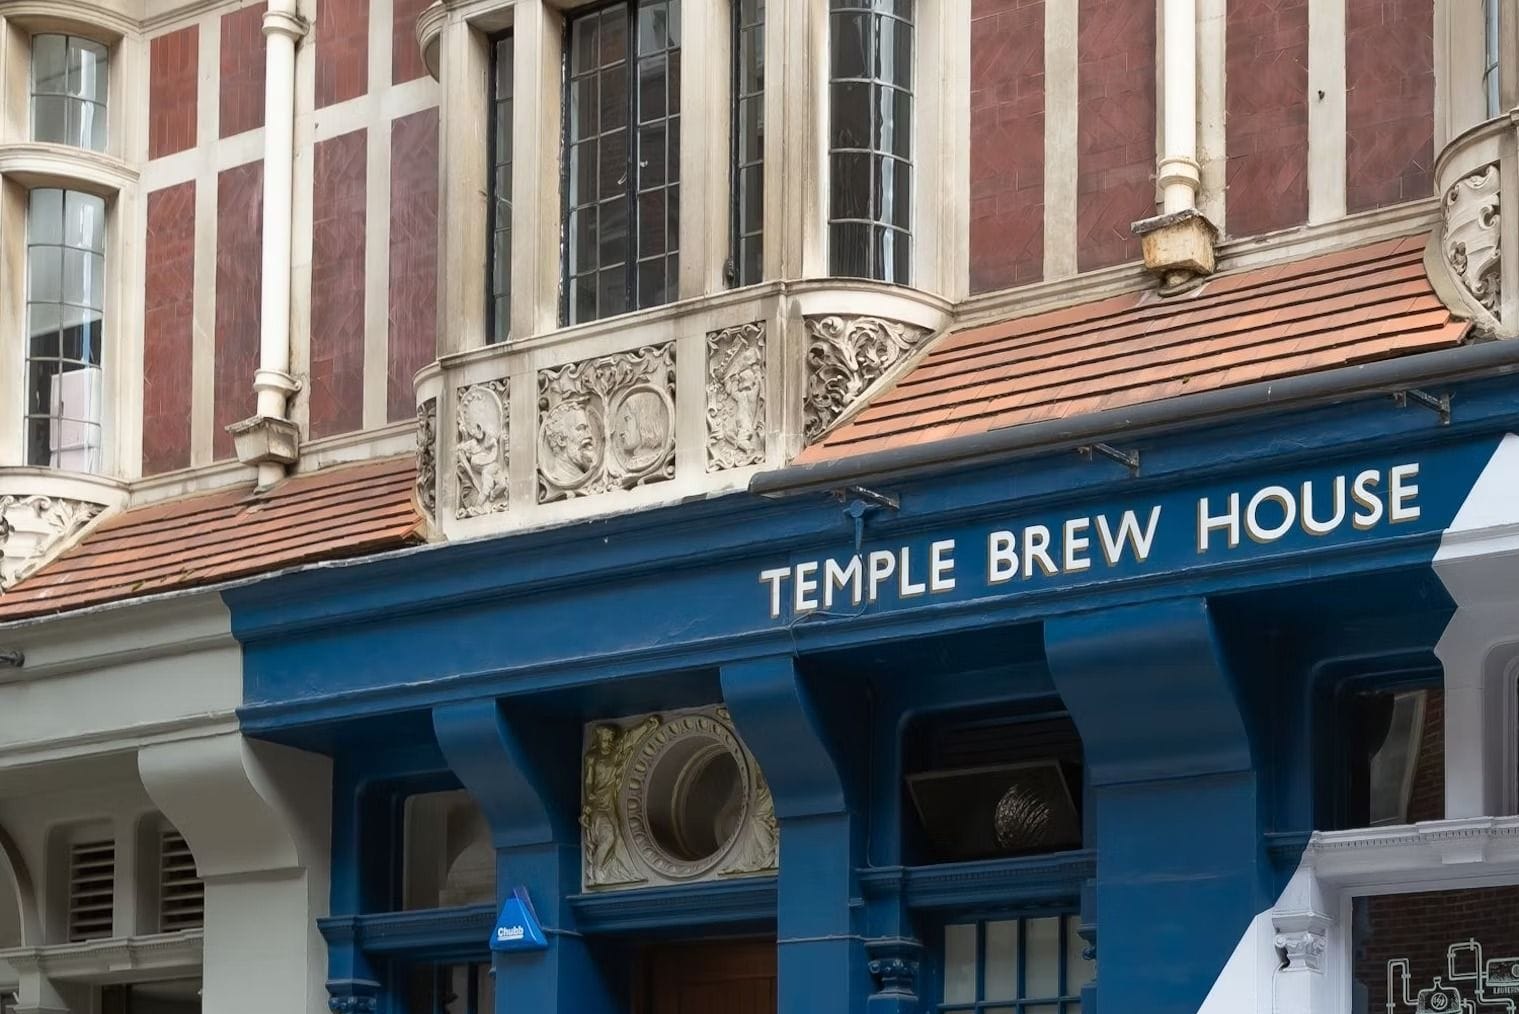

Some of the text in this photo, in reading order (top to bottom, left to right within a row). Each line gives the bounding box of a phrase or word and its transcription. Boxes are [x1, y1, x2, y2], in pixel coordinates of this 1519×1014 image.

[759, 462, 1422, 619] TEMPLE BREW HOUSE
[497, 926, 524, 938] Chubb
